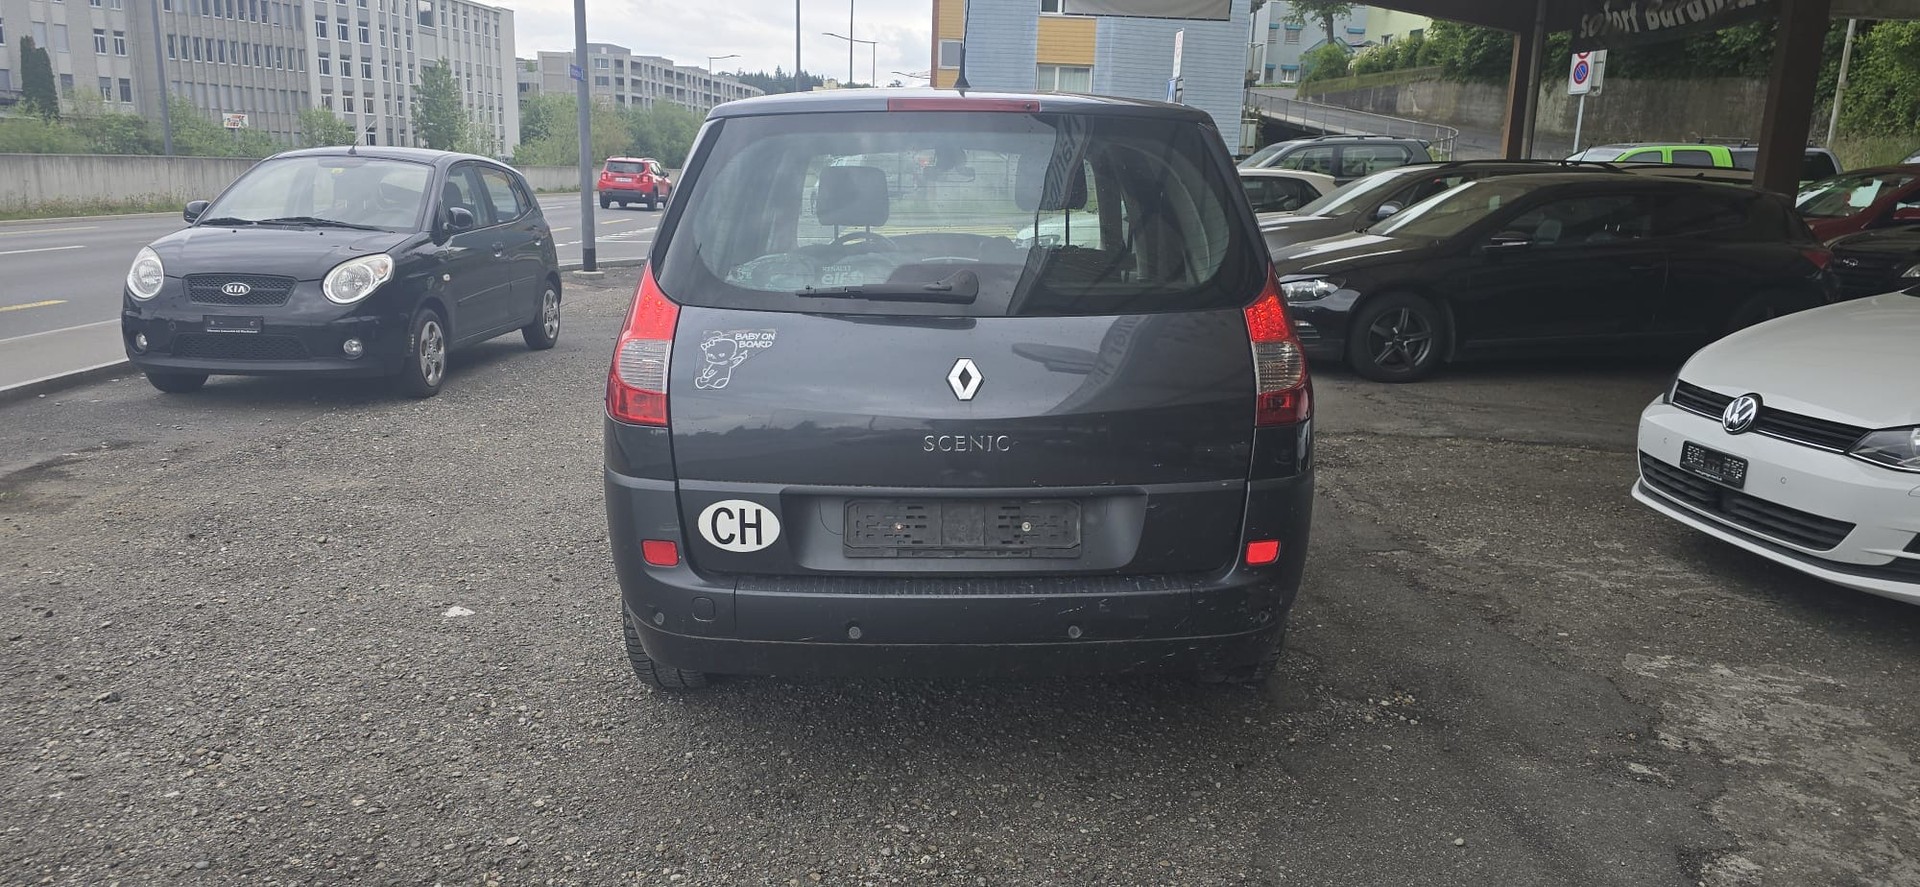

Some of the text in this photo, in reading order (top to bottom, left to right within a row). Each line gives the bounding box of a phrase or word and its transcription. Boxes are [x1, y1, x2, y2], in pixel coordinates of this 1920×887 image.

[226, 285, 246, 293] KIA
[735, 332, 776, 341] BABY ON
[923, 435, 1010, 452] SCENIC
[711, 507, 762, 545] CH
